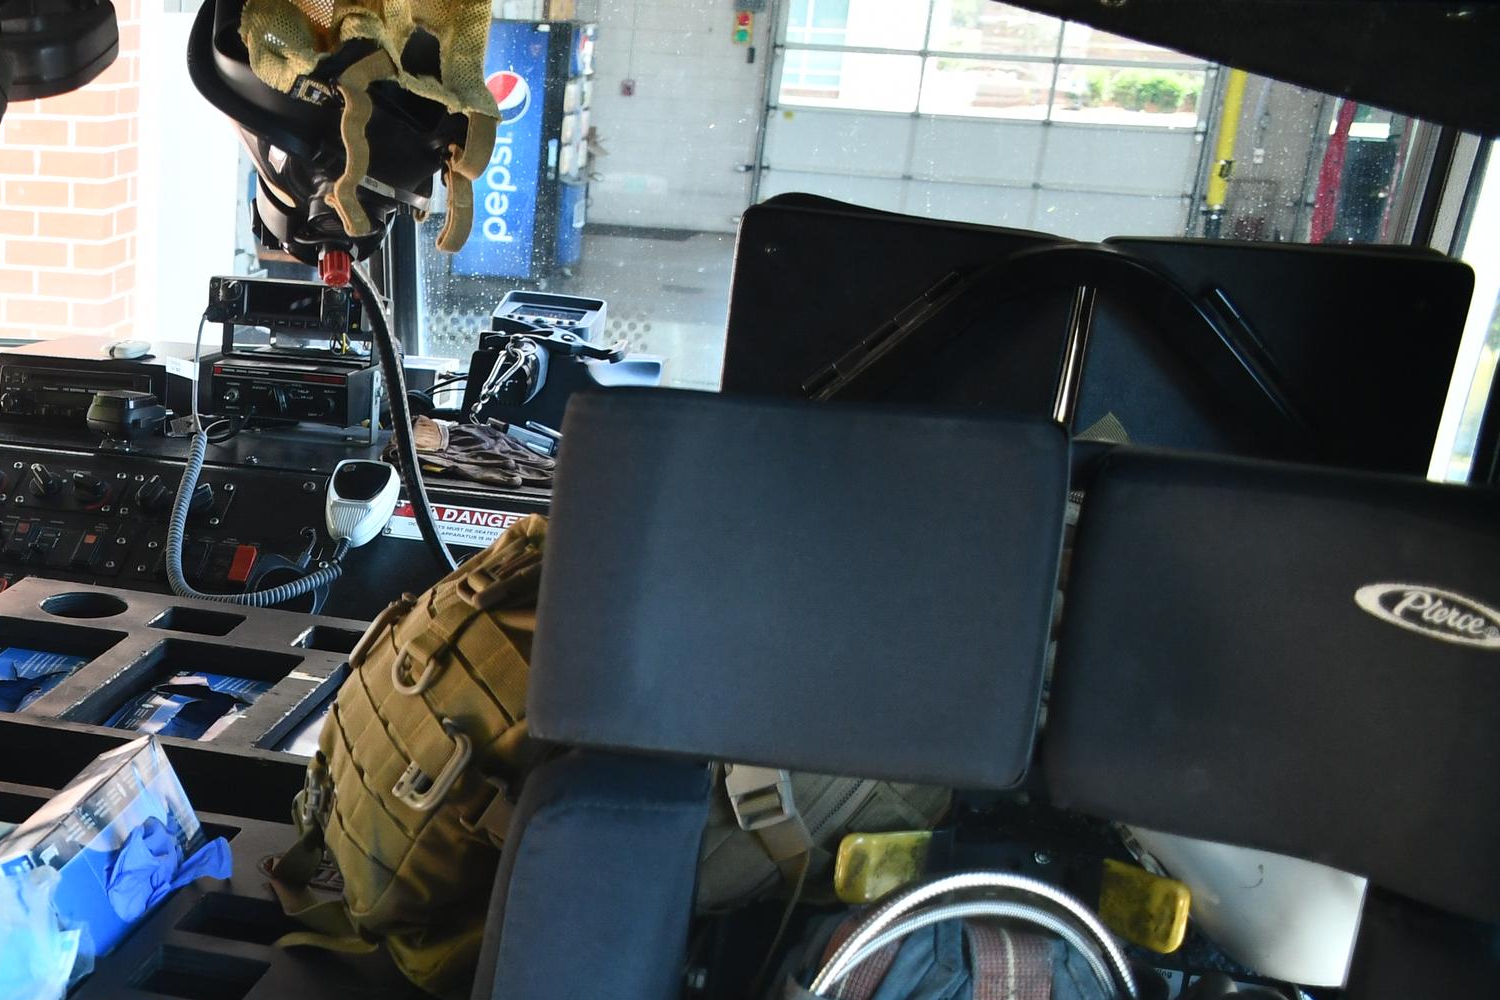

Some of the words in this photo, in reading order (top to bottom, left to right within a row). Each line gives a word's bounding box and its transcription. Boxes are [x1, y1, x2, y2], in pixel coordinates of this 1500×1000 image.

[483, 136, 517, 242] pepsi
[442, 508, 524, 529] DANGE
[1393, 591, 1485, 634] Pierce
